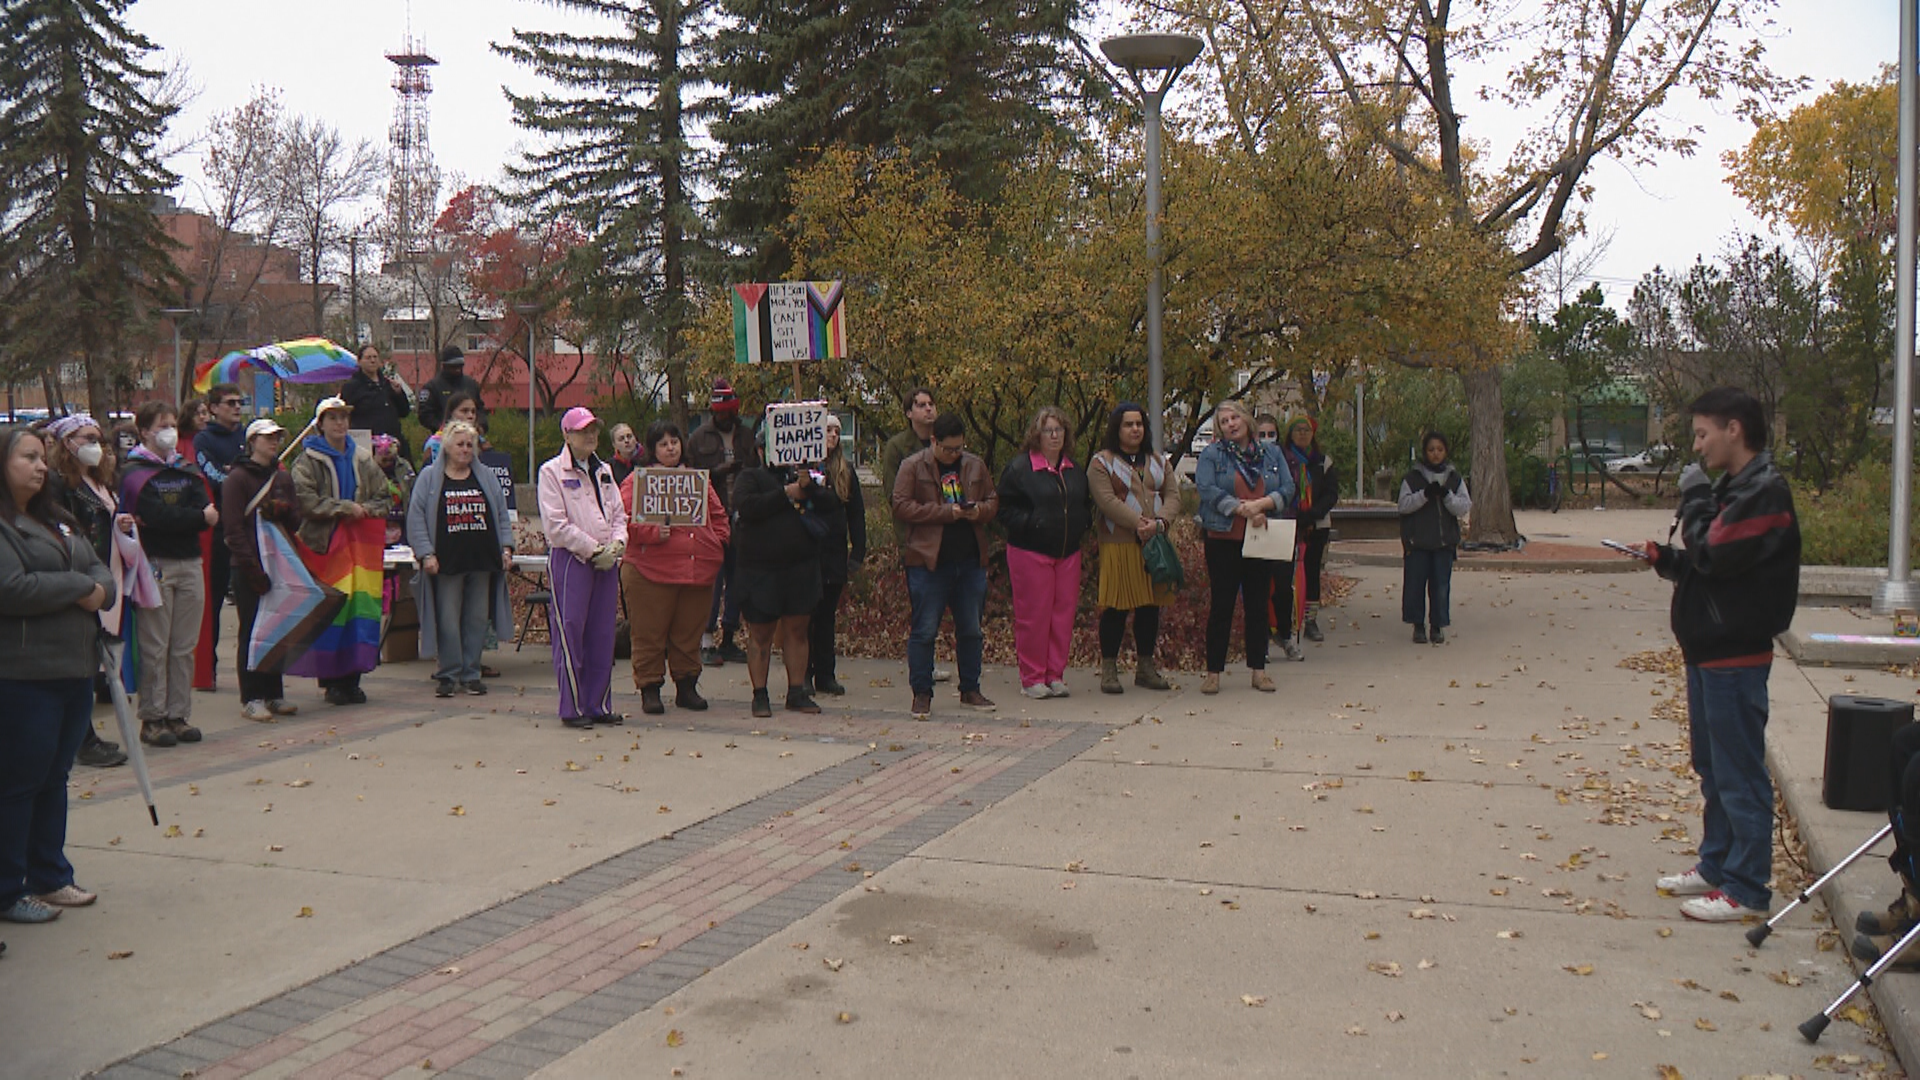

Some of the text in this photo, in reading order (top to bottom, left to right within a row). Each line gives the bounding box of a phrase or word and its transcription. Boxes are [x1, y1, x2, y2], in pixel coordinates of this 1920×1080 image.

[792, 297, 806, 308] YOU
[773, 311, 805, 324] CAN'T
[774, 337, 797, 350] WITH
[774, 410, 822, 428] BILL 137
[776, 427, 823, 446] HARMS
[775, 443, 822, 462] YOUTH
[646, 475, 701, 496] REPEAL
[446, 503, 486, 514] HEALTH
[643, 495, 702, 518] BILL 137
